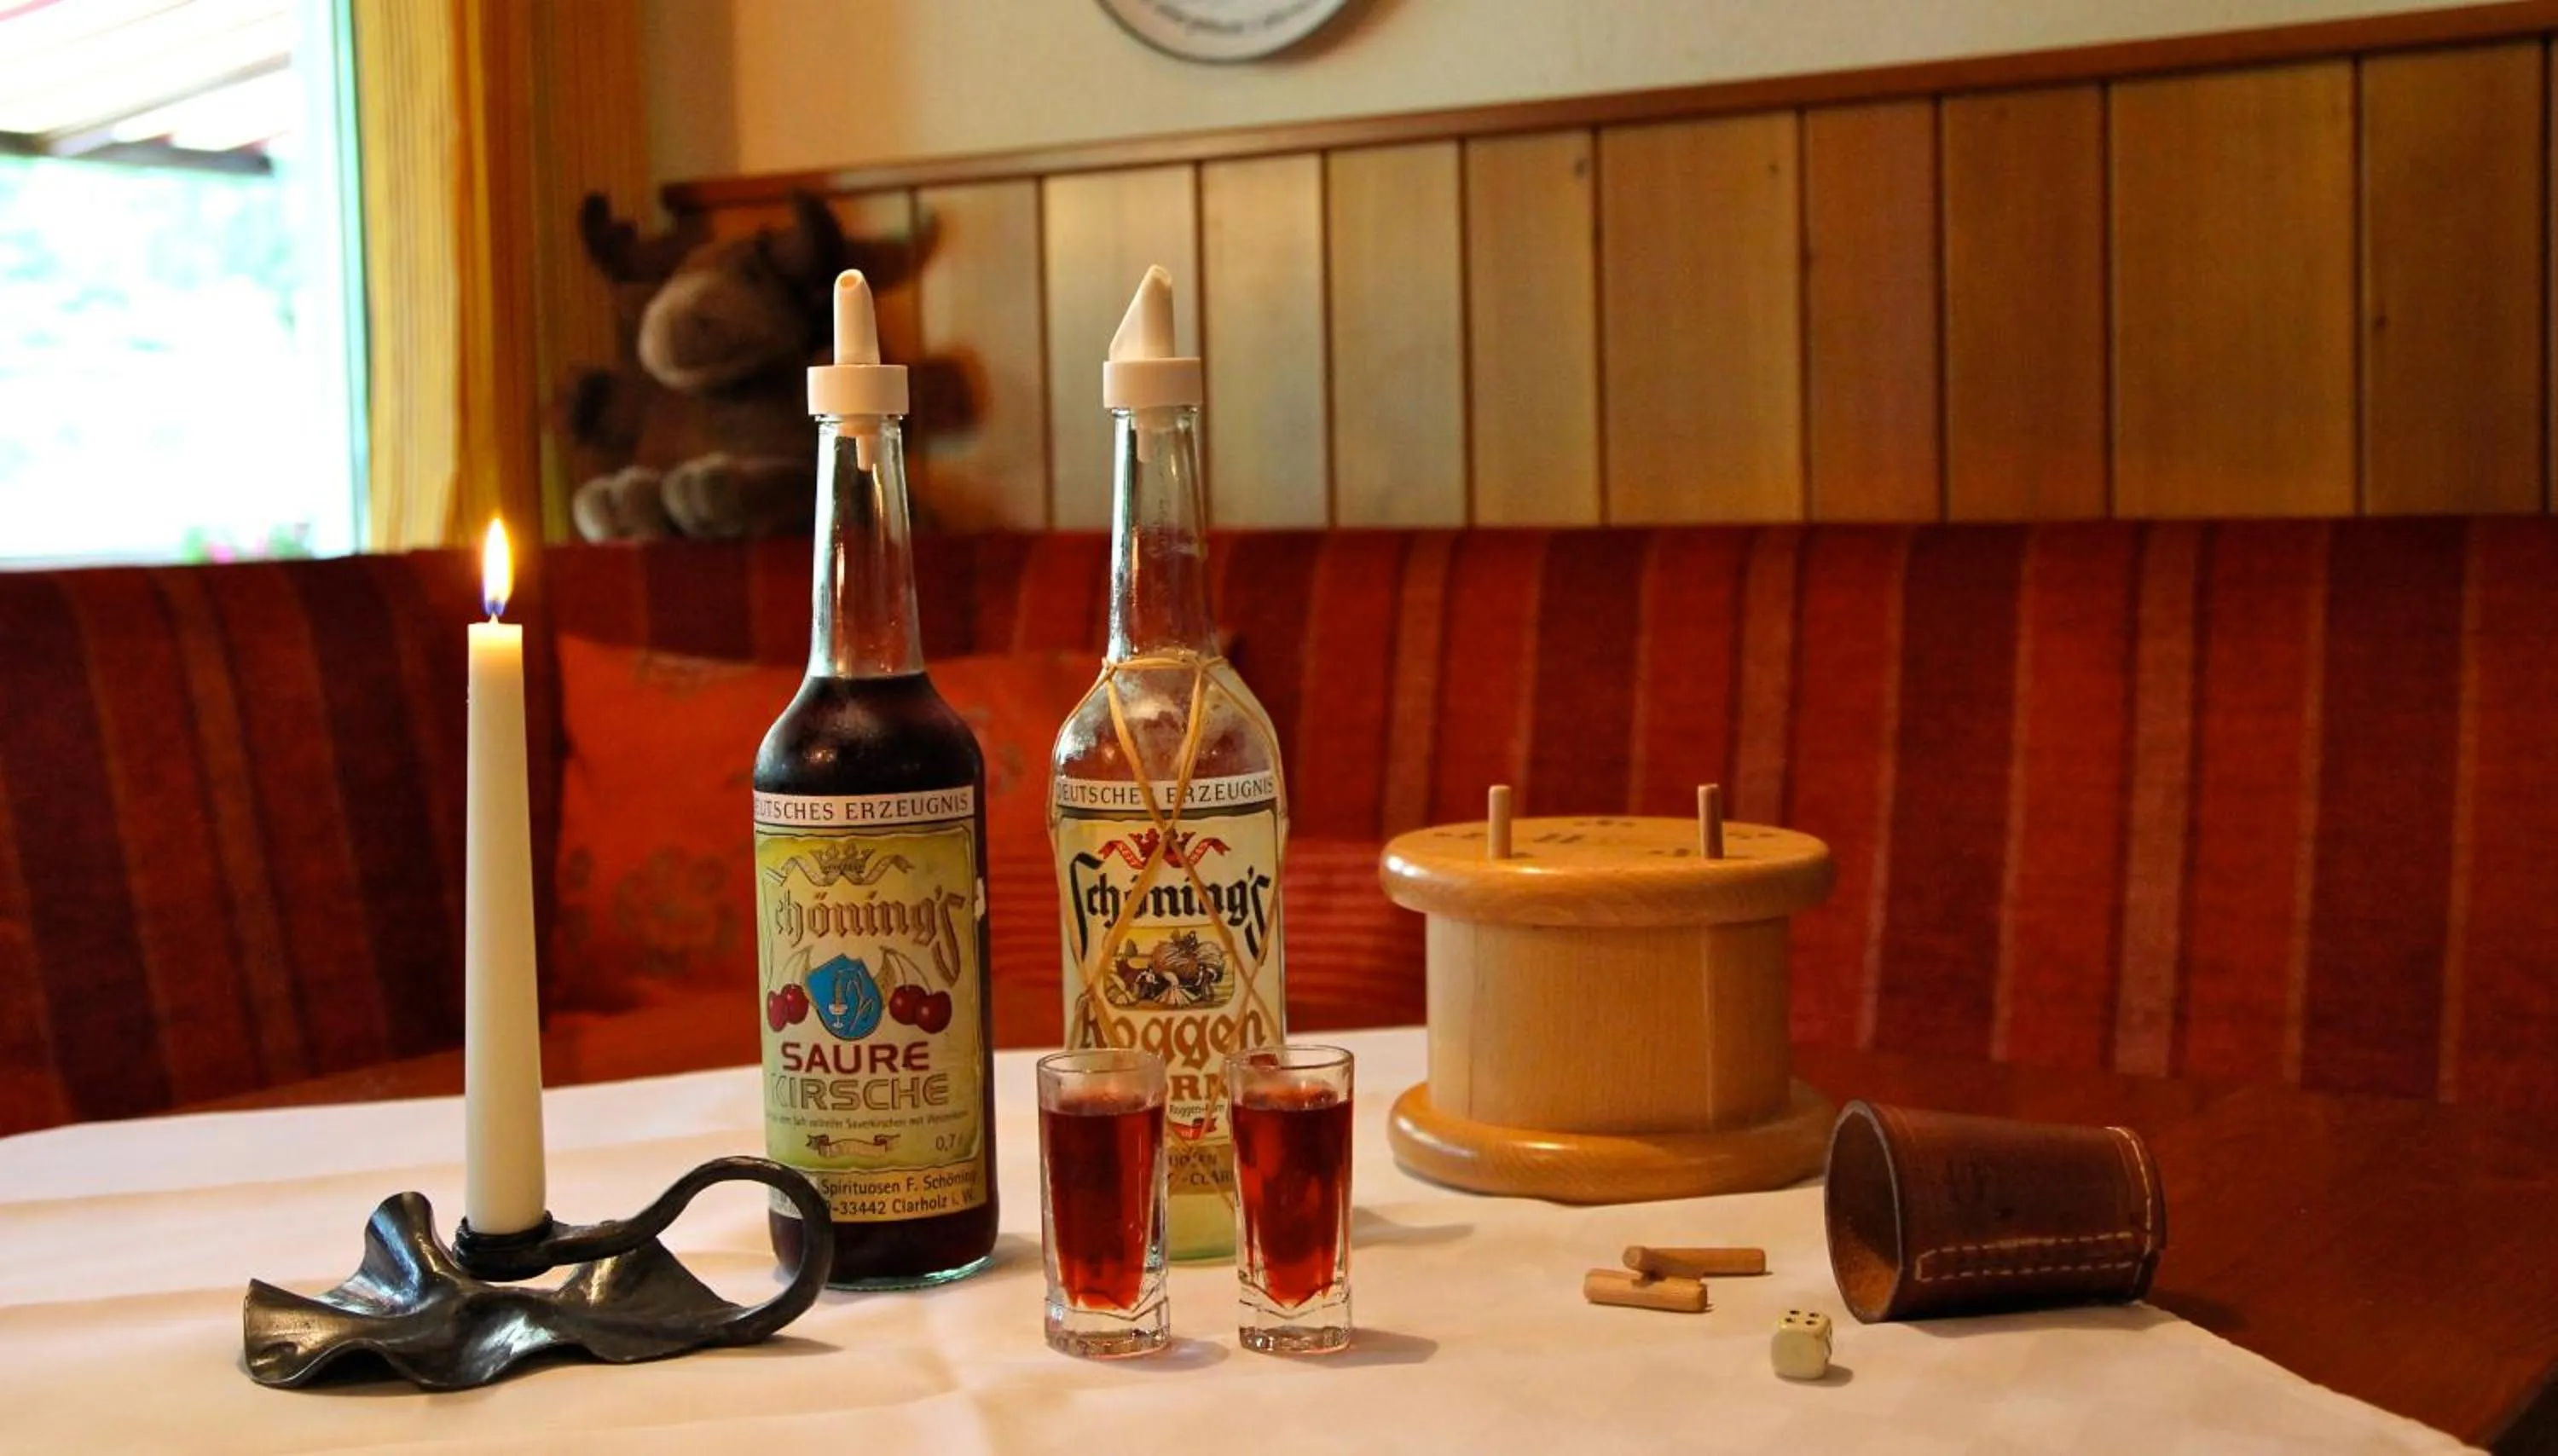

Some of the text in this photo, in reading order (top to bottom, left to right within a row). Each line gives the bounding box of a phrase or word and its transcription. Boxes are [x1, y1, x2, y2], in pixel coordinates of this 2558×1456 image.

[1056, 776, 1275, 805] DEUTSCHE ERZEUGNIS
[845, 793, 969, 820] ERZEUGNIS
[781, 1040, 930, 1074] SAURE
[771, 1072, 949, 1111] KIRSCHE
[820, 1177, 900, 1196] Spirituosen
[906, 1176, 919, 1193] F.
[826, 1200, 887, 1216] -33442
[892, 1195, 947, 1214] Clarholz
